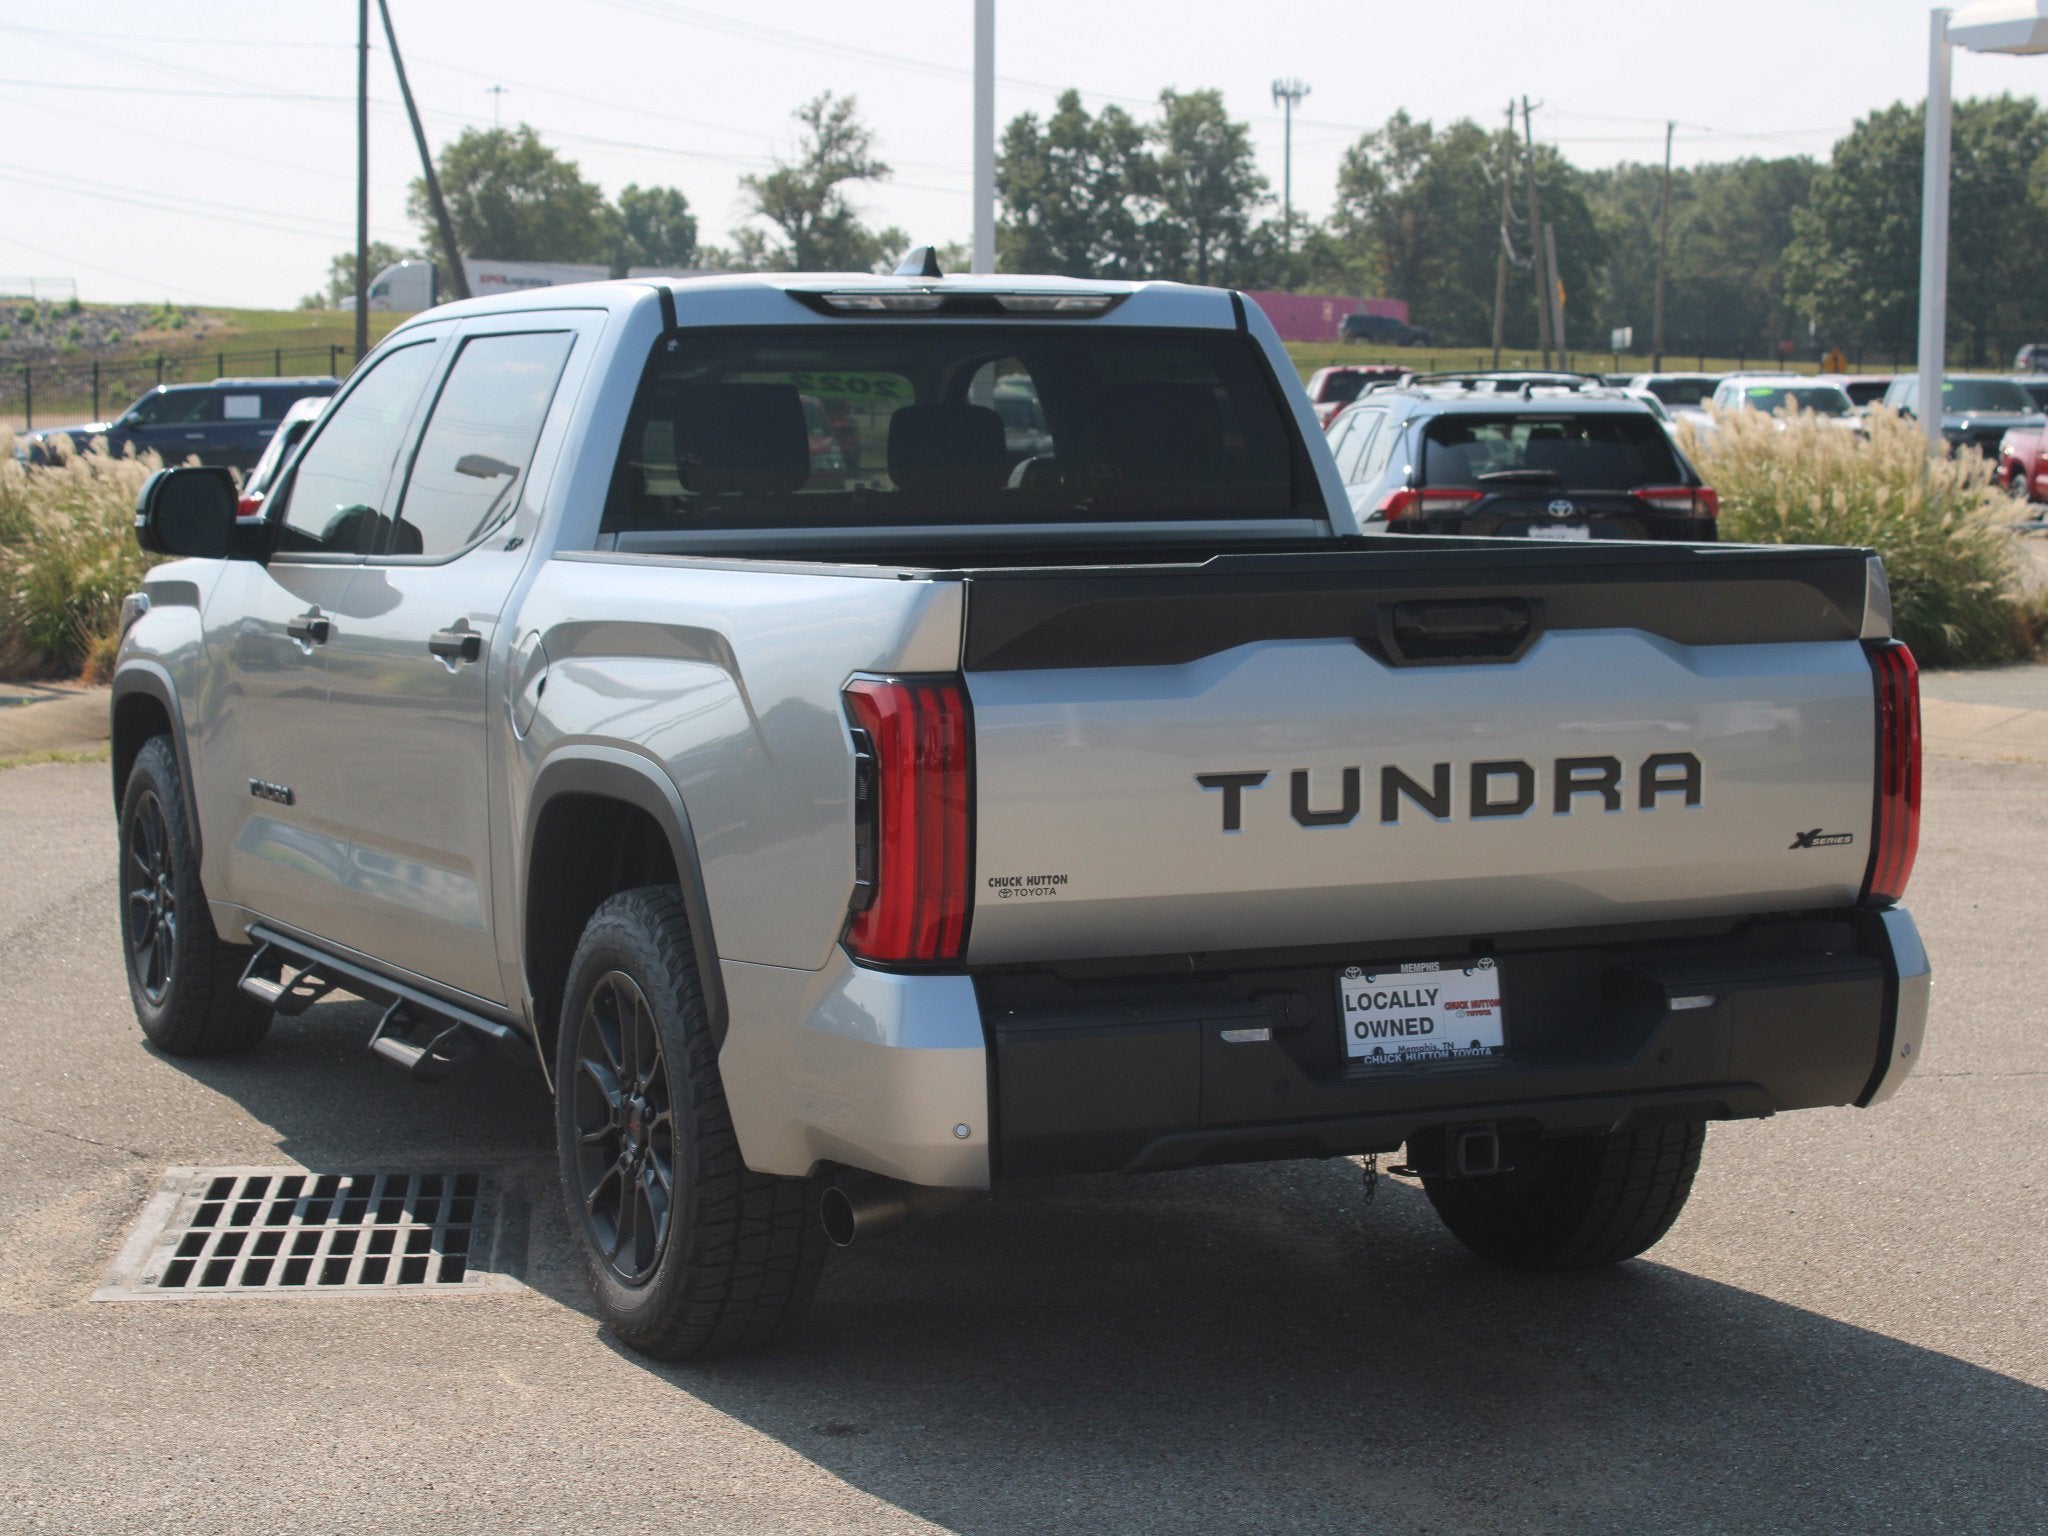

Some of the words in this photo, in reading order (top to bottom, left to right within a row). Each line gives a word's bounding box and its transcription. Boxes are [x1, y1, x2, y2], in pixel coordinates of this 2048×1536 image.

[1196, 752, 1703, 833] TUNDRA
[988, 877, 1022, 888] CHUCK
[1026, 874, 1068, 886] HUTTON
[1014, 887, 1057, 897] TOYOTA
[1400, 962, 1440, 974] MEMPHIS
[1345, 988, 1439, 1012] LOCALLY
[1444, 1001, 1469, 1010] CHUCK
[1354, 1017, 1434, 1040] OWNED
[1442, 1042, 1455, 1051] TN
[1364, 1054, 1402, 1064] CHUCK
[1406, 1051, 1449, 1061] HUTTON
[1452, 1047, 1492, 1057] TOYOTA
